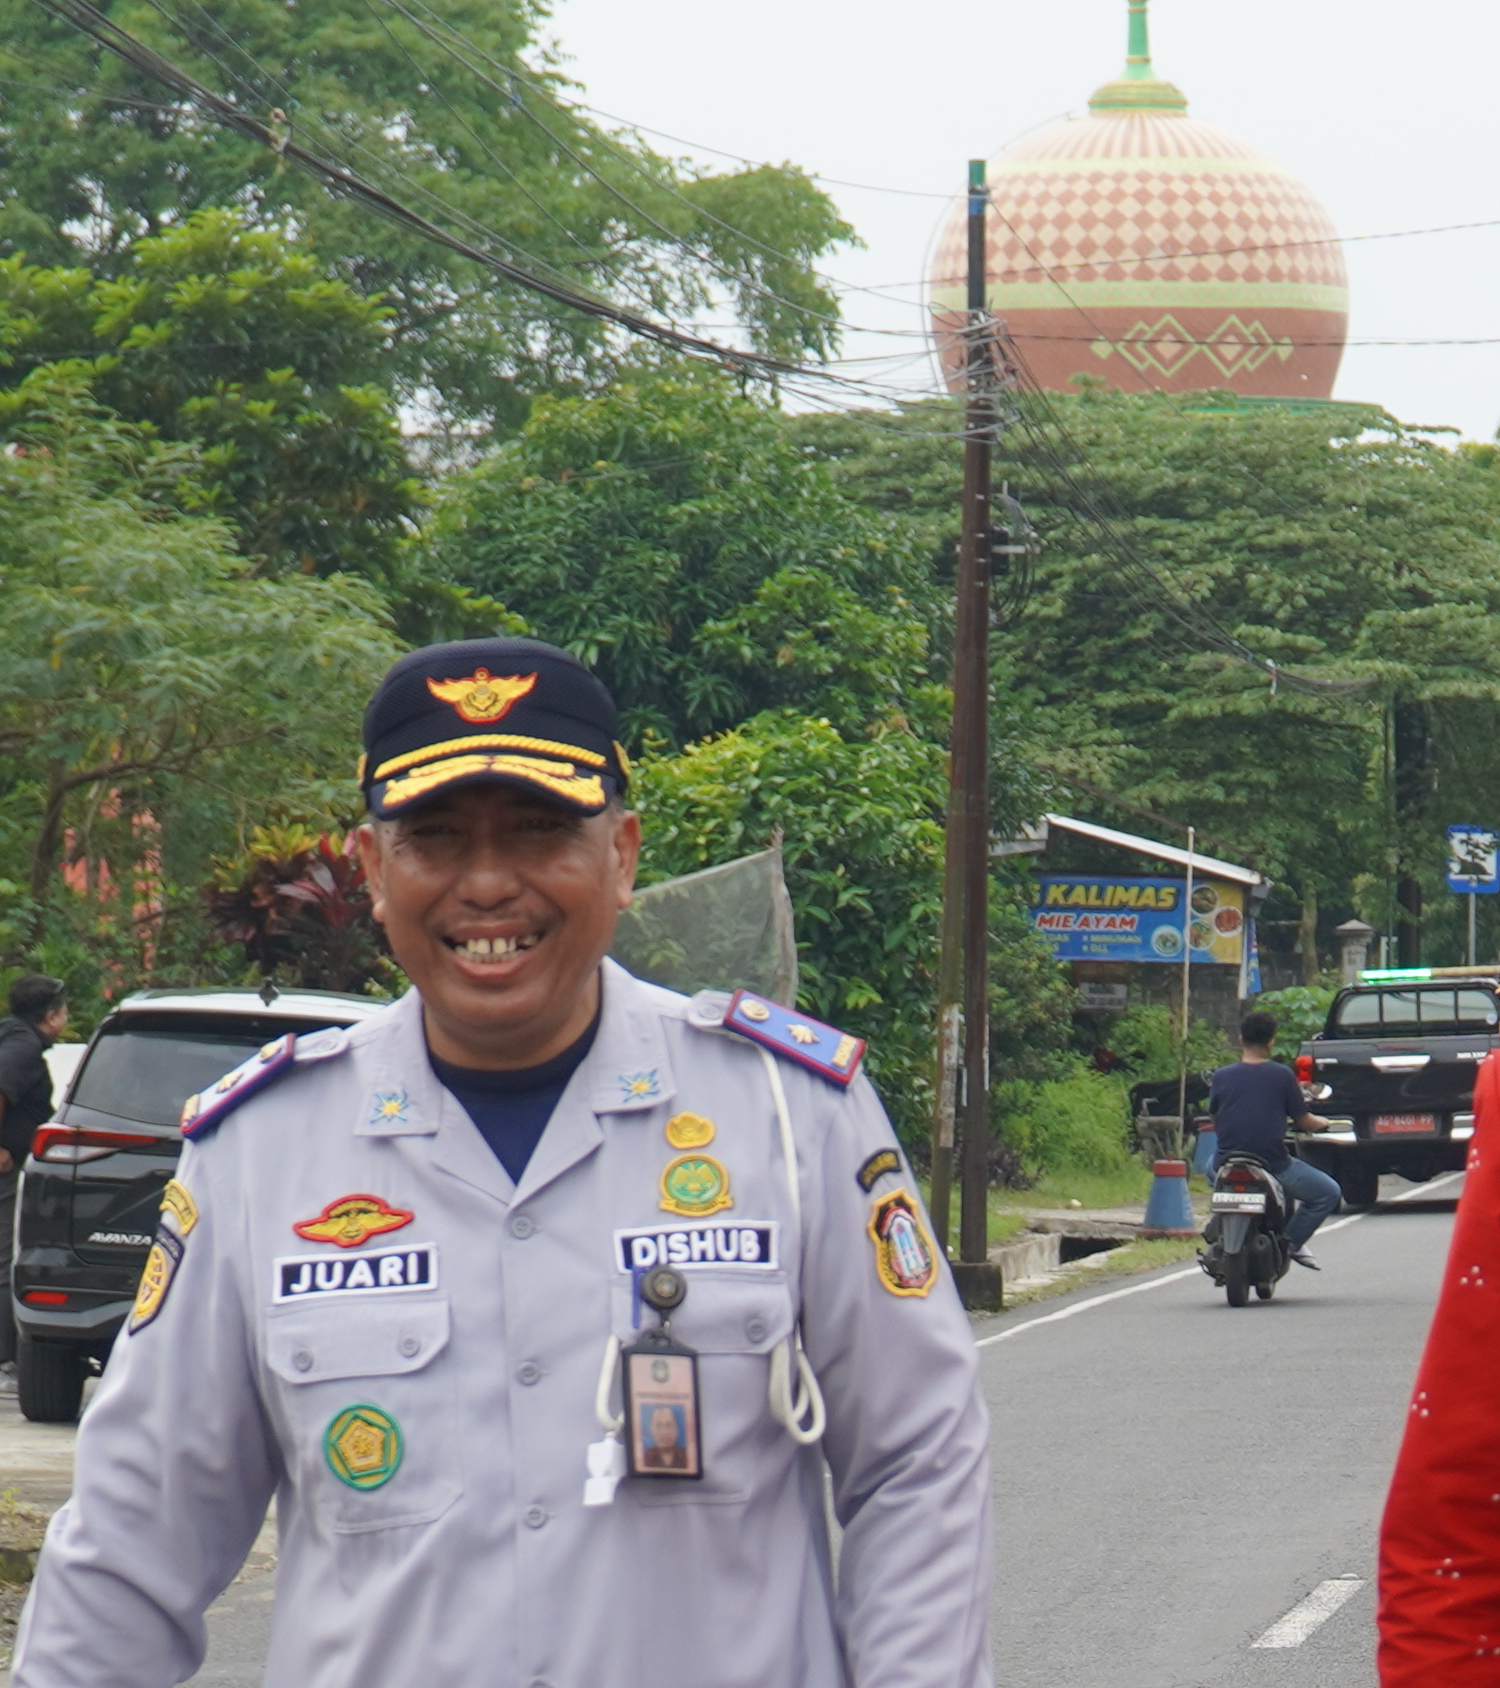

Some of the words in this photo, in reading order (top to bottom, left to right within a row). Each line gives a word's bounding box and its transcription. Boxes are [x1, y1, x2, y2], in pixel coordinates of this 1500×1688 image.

[1046, 883, 1177, 908] KALIMAS
[1036, 912, 1074, 930] MIE
[1077, 914, 1138, 931] AYAM
[87, 1231, 152, 1246] AVANZA
[631, 1228, 762, 1267] DISHUB
[290, 1252, 419, 1293] JUARI
